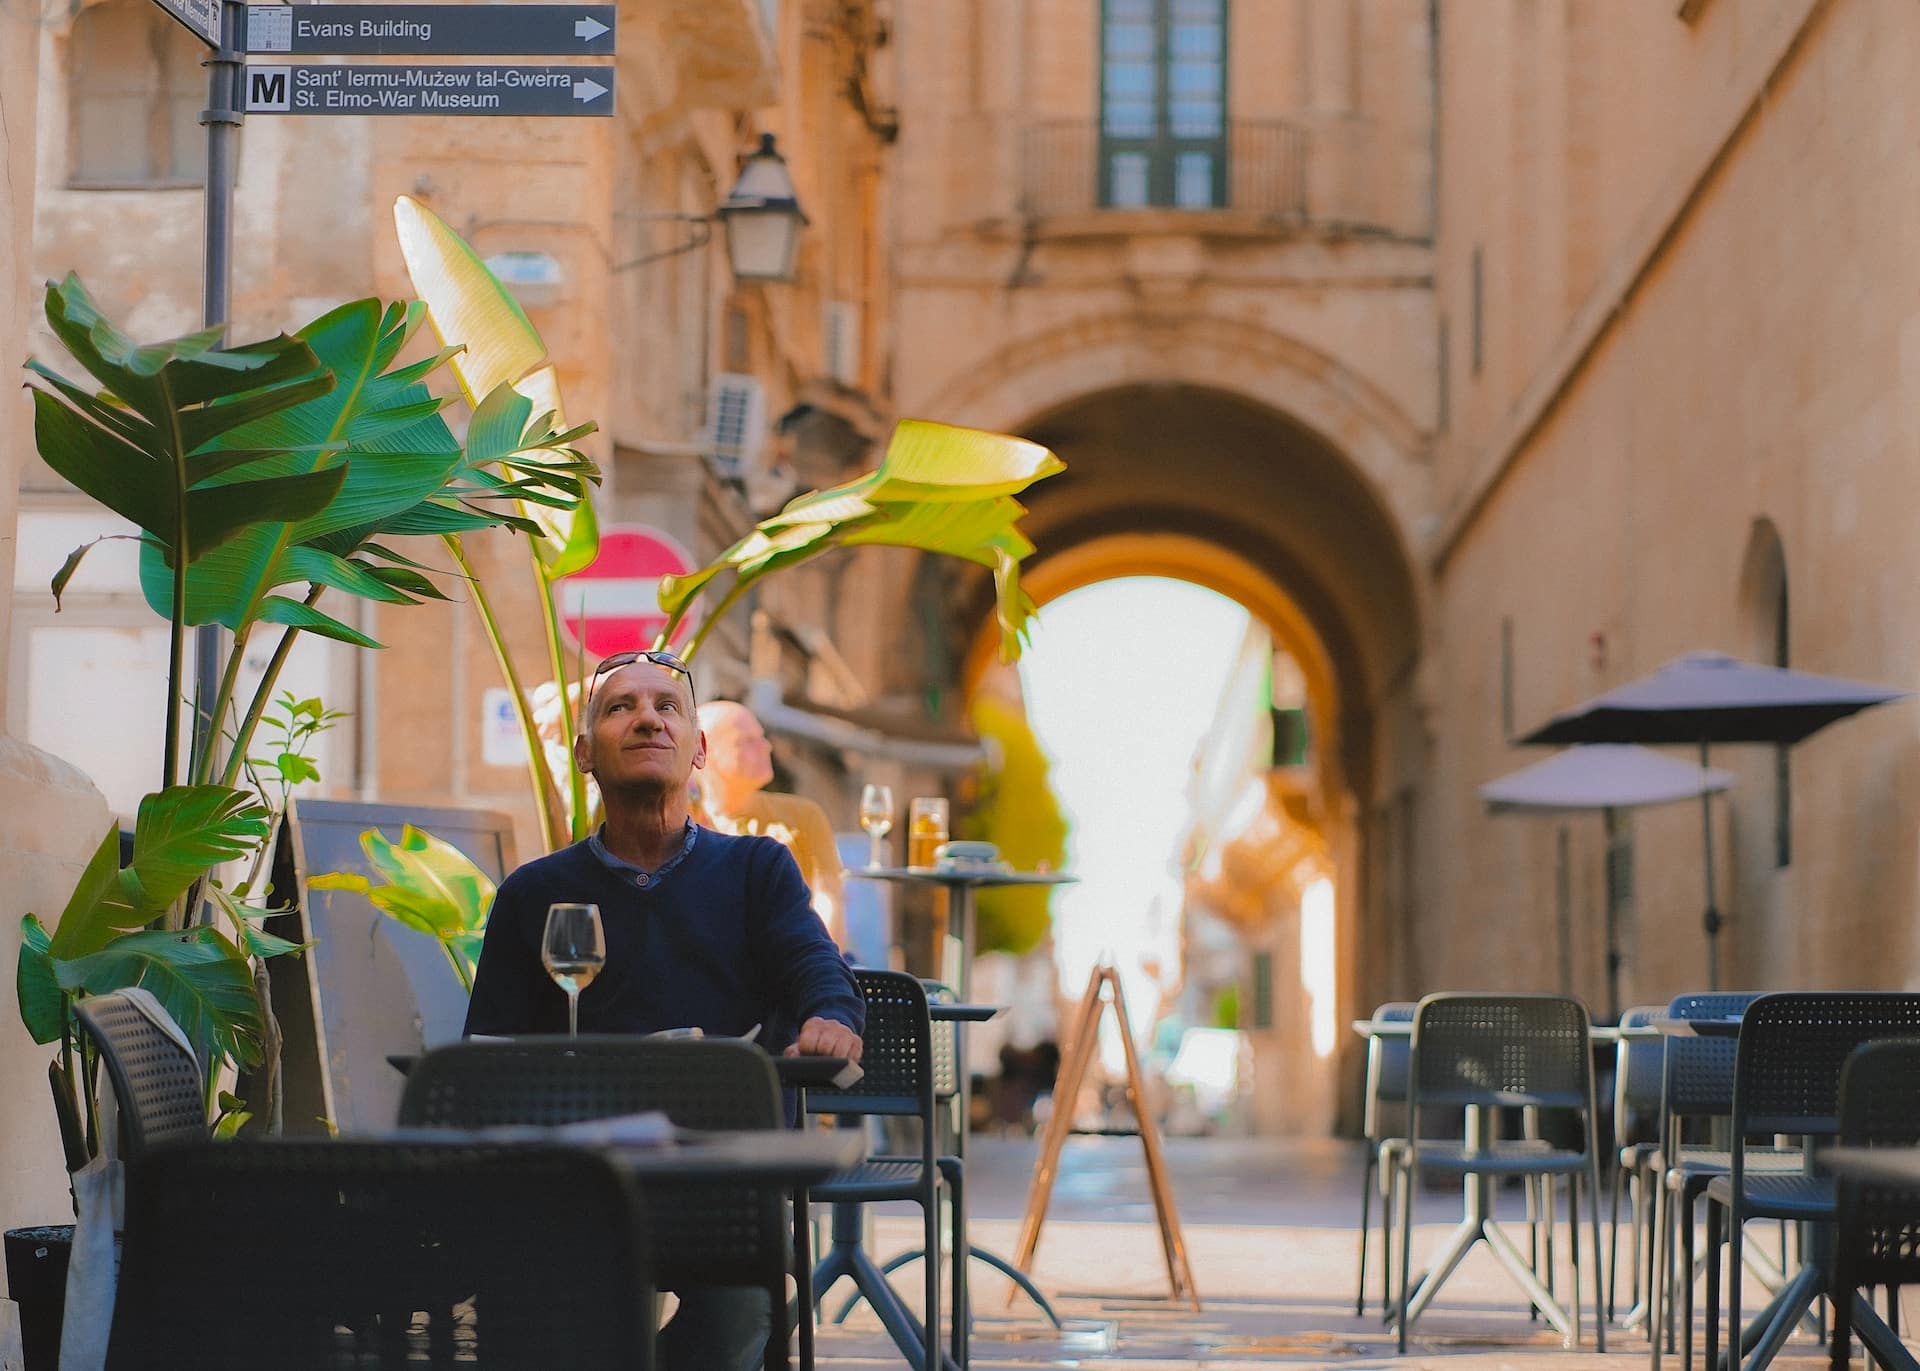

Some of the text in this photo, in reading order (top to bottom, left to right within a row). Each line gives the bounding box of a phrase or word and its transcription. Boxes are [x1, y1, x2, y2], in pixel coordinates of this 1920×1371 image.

[298, 20, 431, 41] Evans Building
[252, 73, 286, 104] M
[296, 69, 571, 88] Sant' Iermu-Mużew tal-Gwerra
[295, 89, 499, 108] St. Elmo-War Museum
